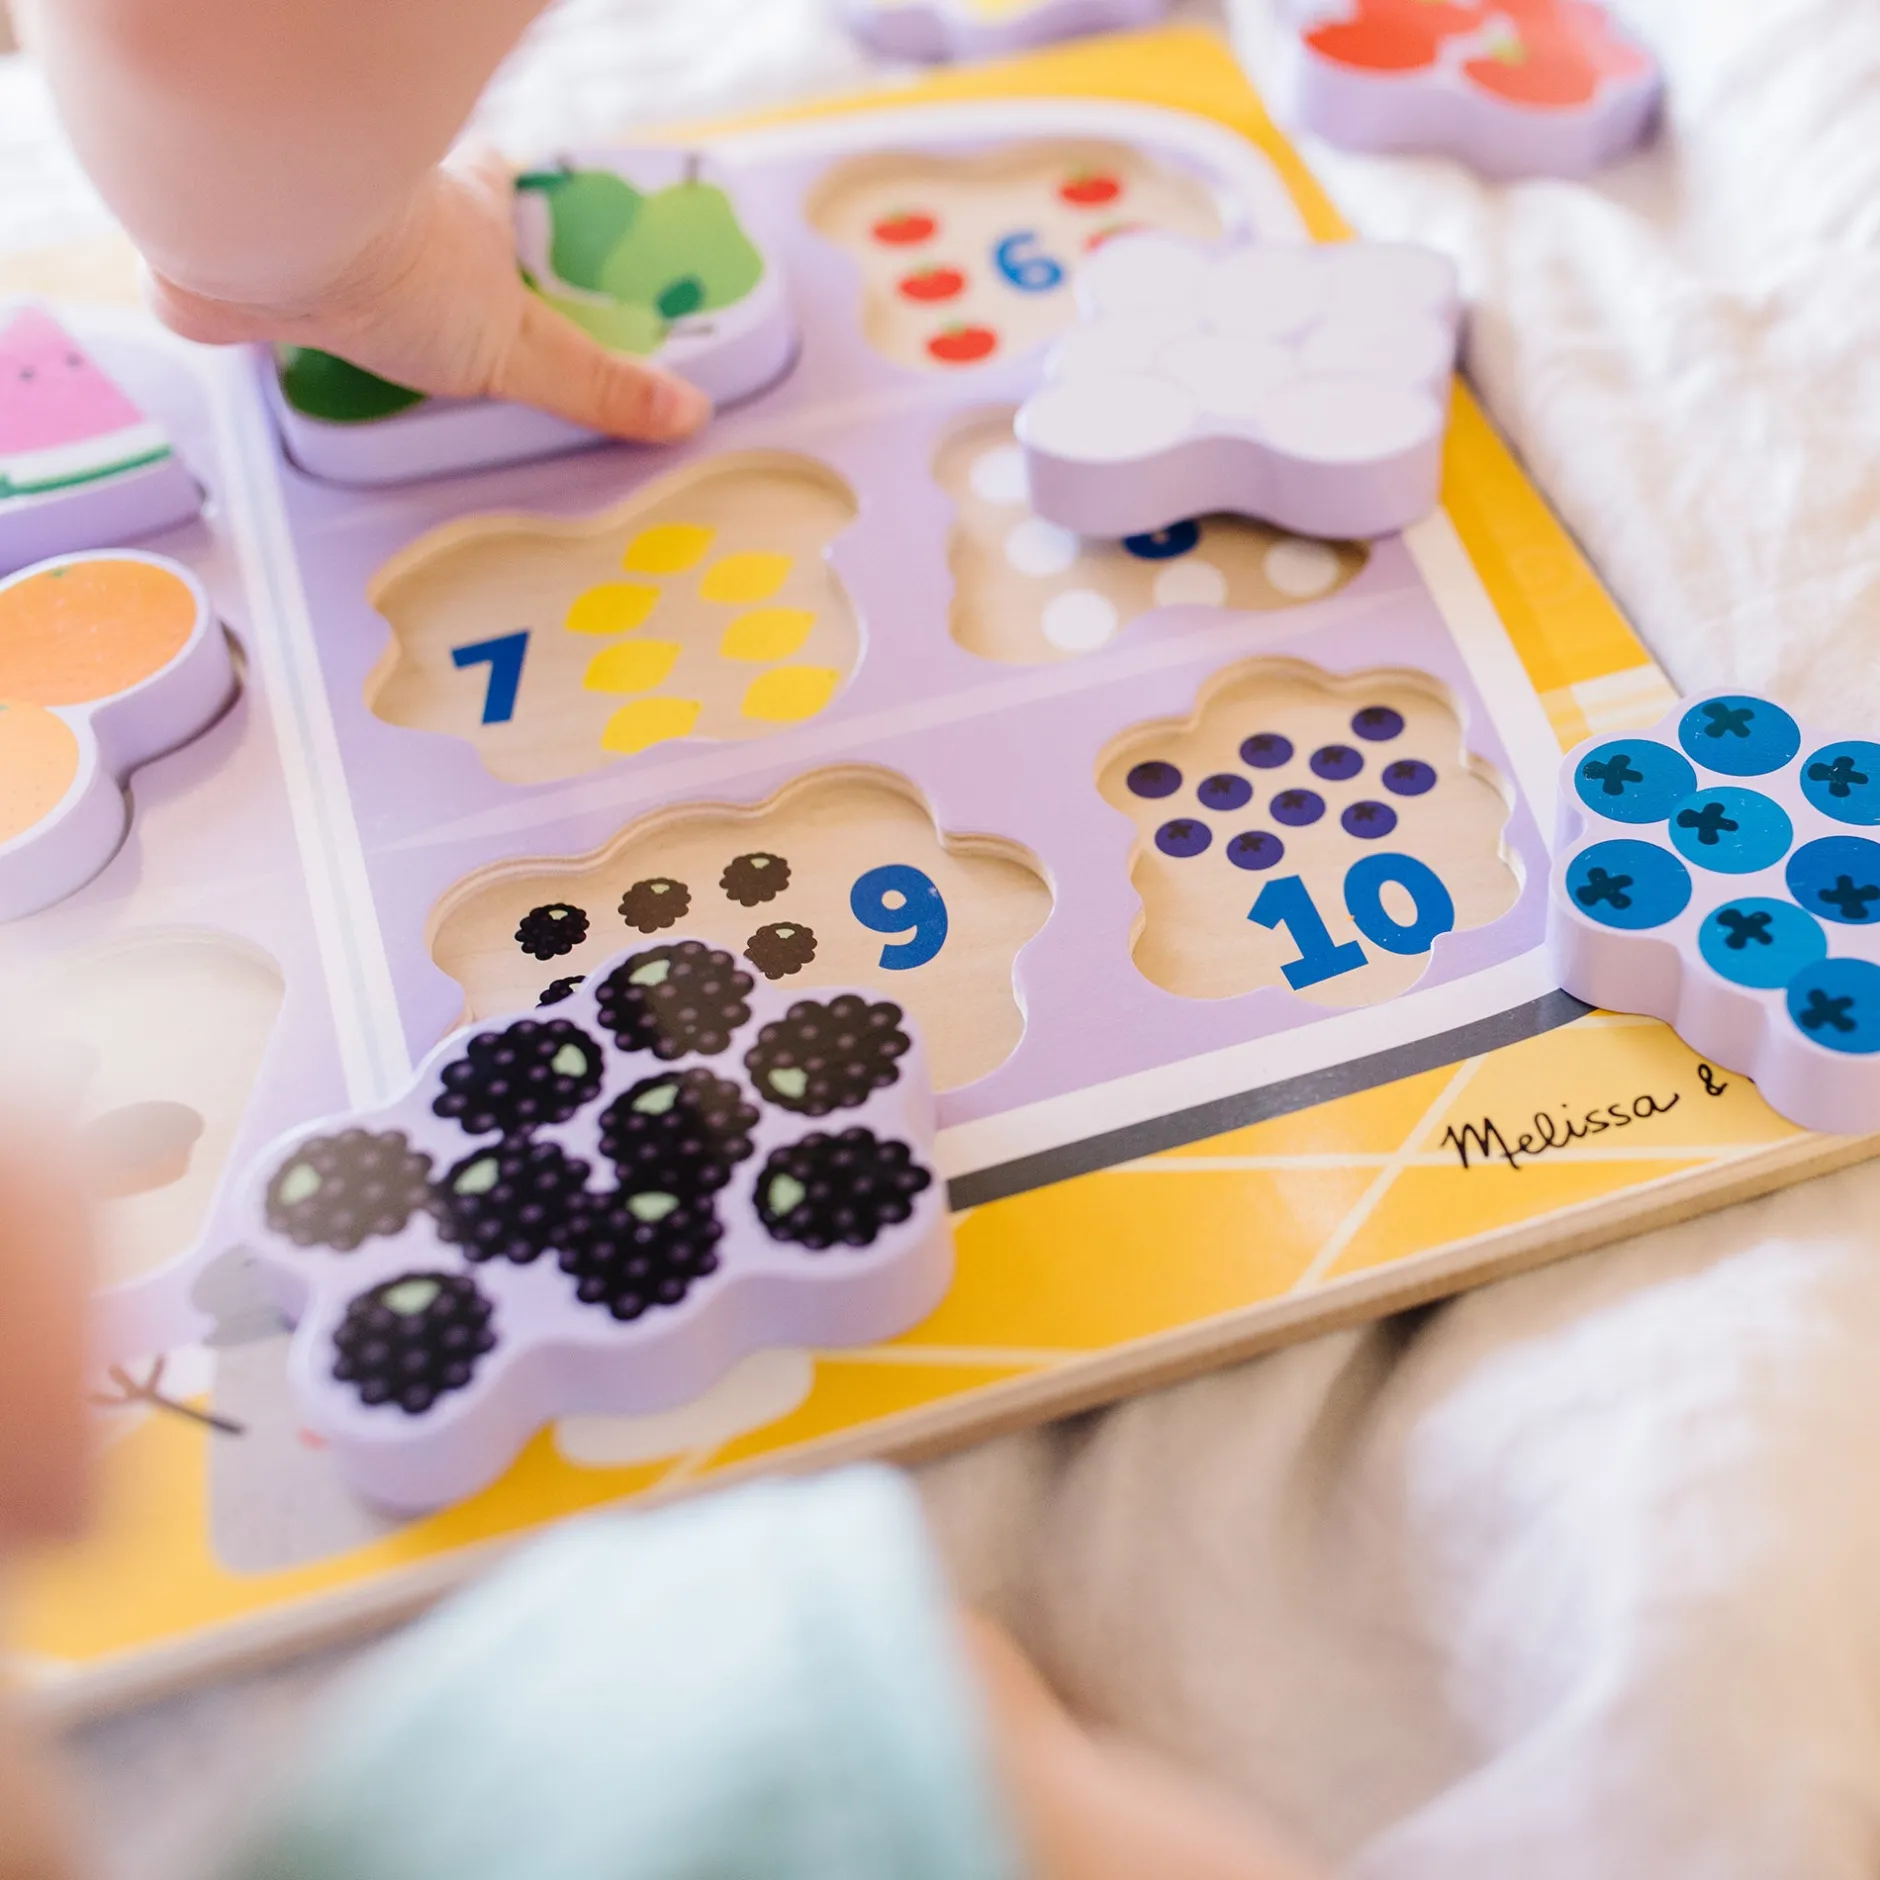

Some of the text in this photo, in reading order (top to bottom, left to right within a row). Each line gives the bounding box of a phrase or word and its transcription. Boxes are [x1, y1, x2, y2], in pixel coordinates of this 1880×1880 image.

[993, 234, 1064, 293] 6
[450, 630, 531, 725] 7
[850, 864, 949, 971] 9
[1247, 852, 1455, 991] 10
[1441, 1062, 1729, 1170] Melissa &
